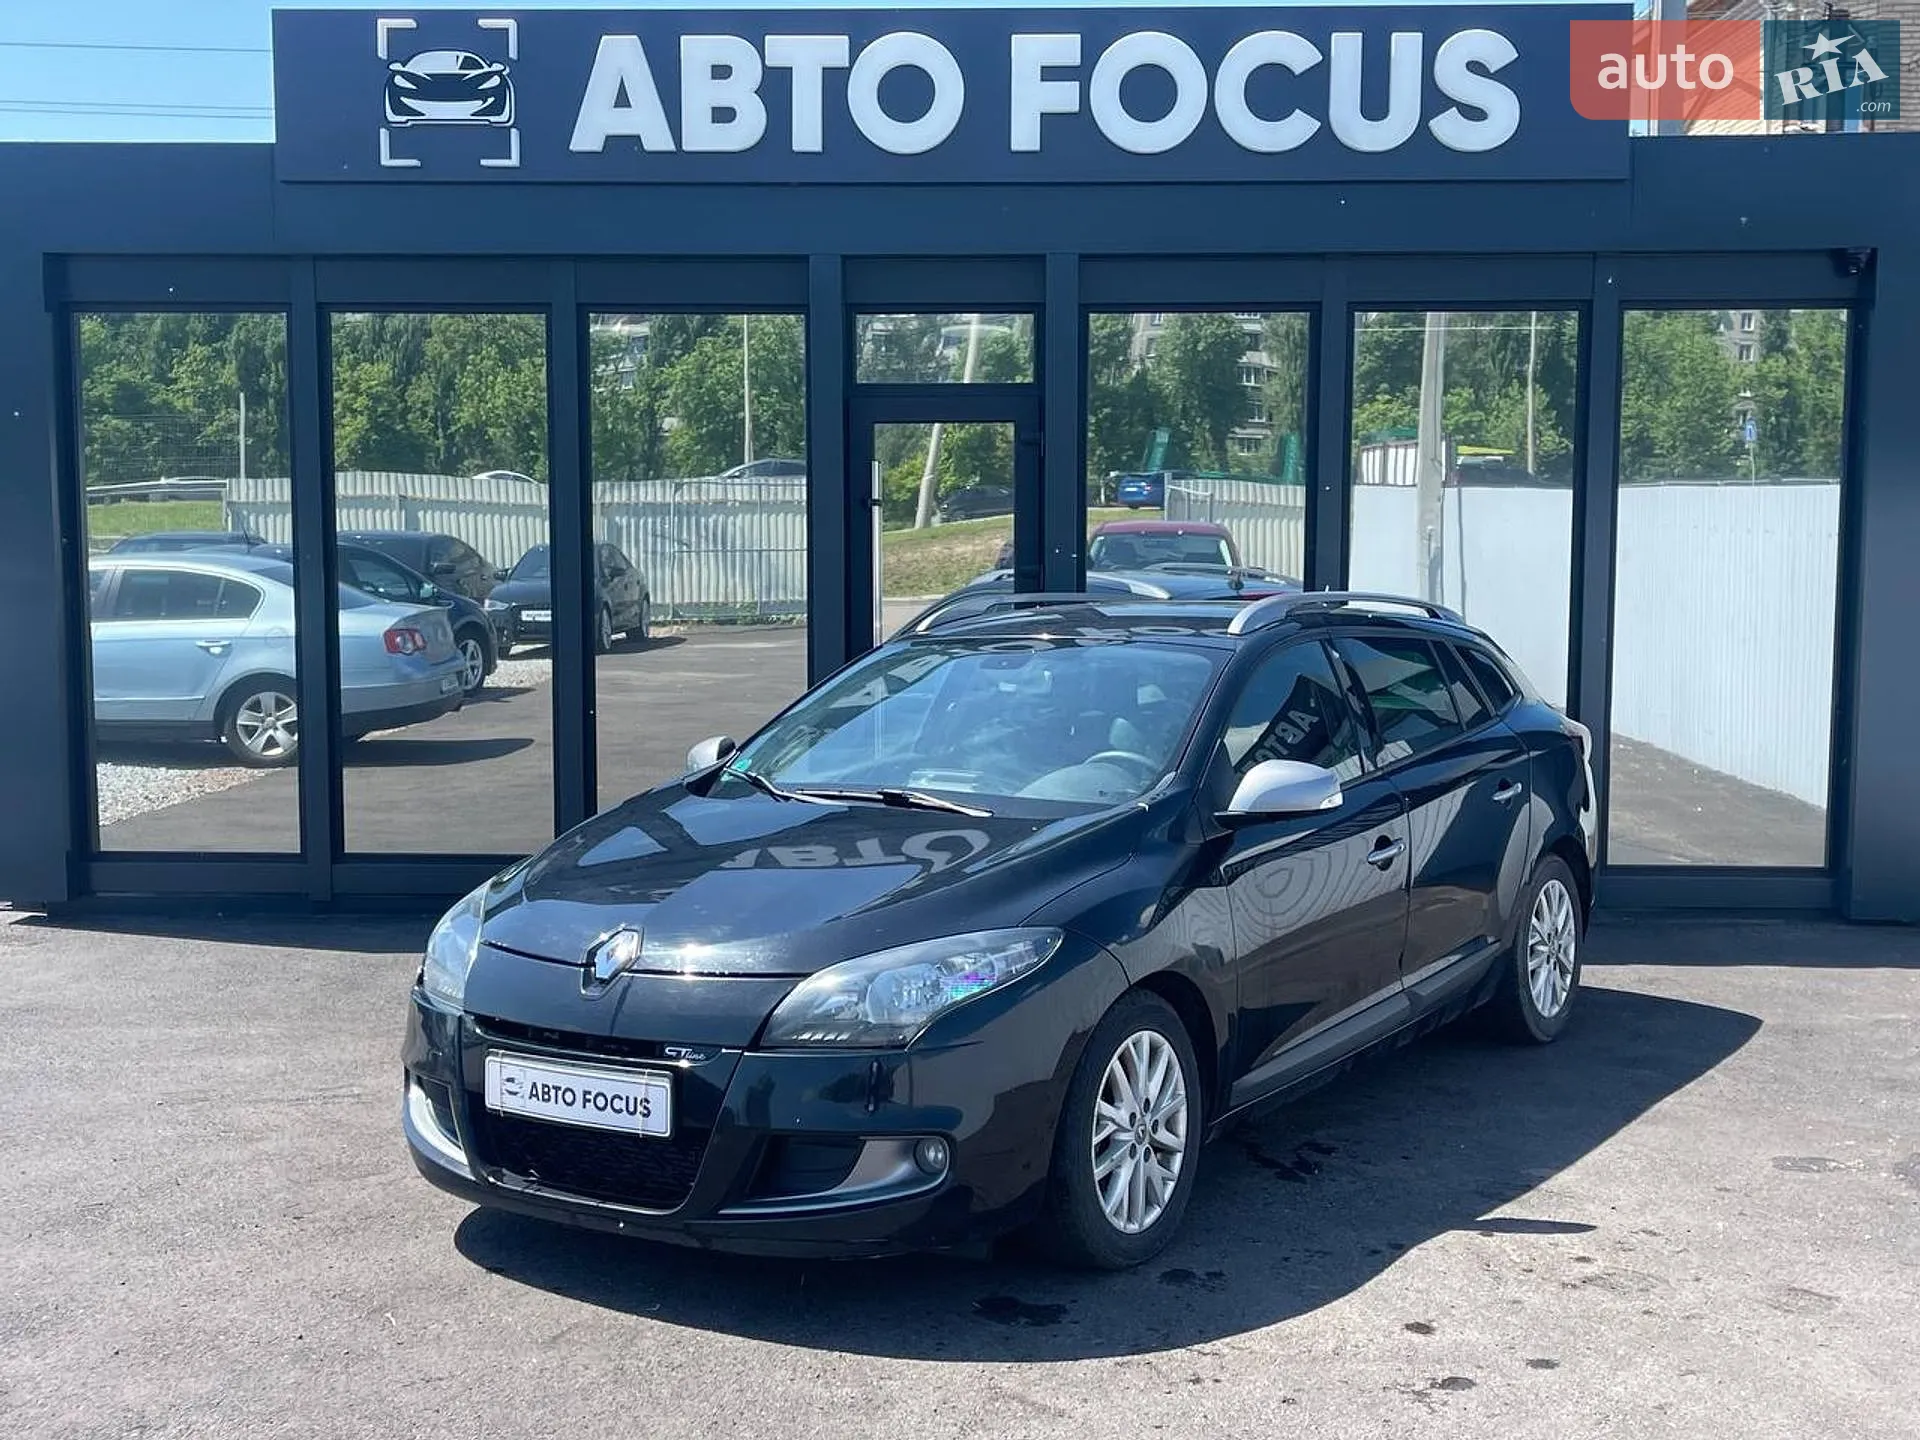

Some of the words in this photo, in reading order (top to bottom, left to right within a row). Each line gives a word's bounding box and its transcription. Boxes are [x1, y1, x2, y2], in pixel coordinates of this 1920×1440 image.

[569, 32, 964, 153] АВТО
[1010, 29, 1521, 153] FOCUS
[528, 1081, 577, 1107] АВТО
[582, 1089, 652, 1119] FOCUS
